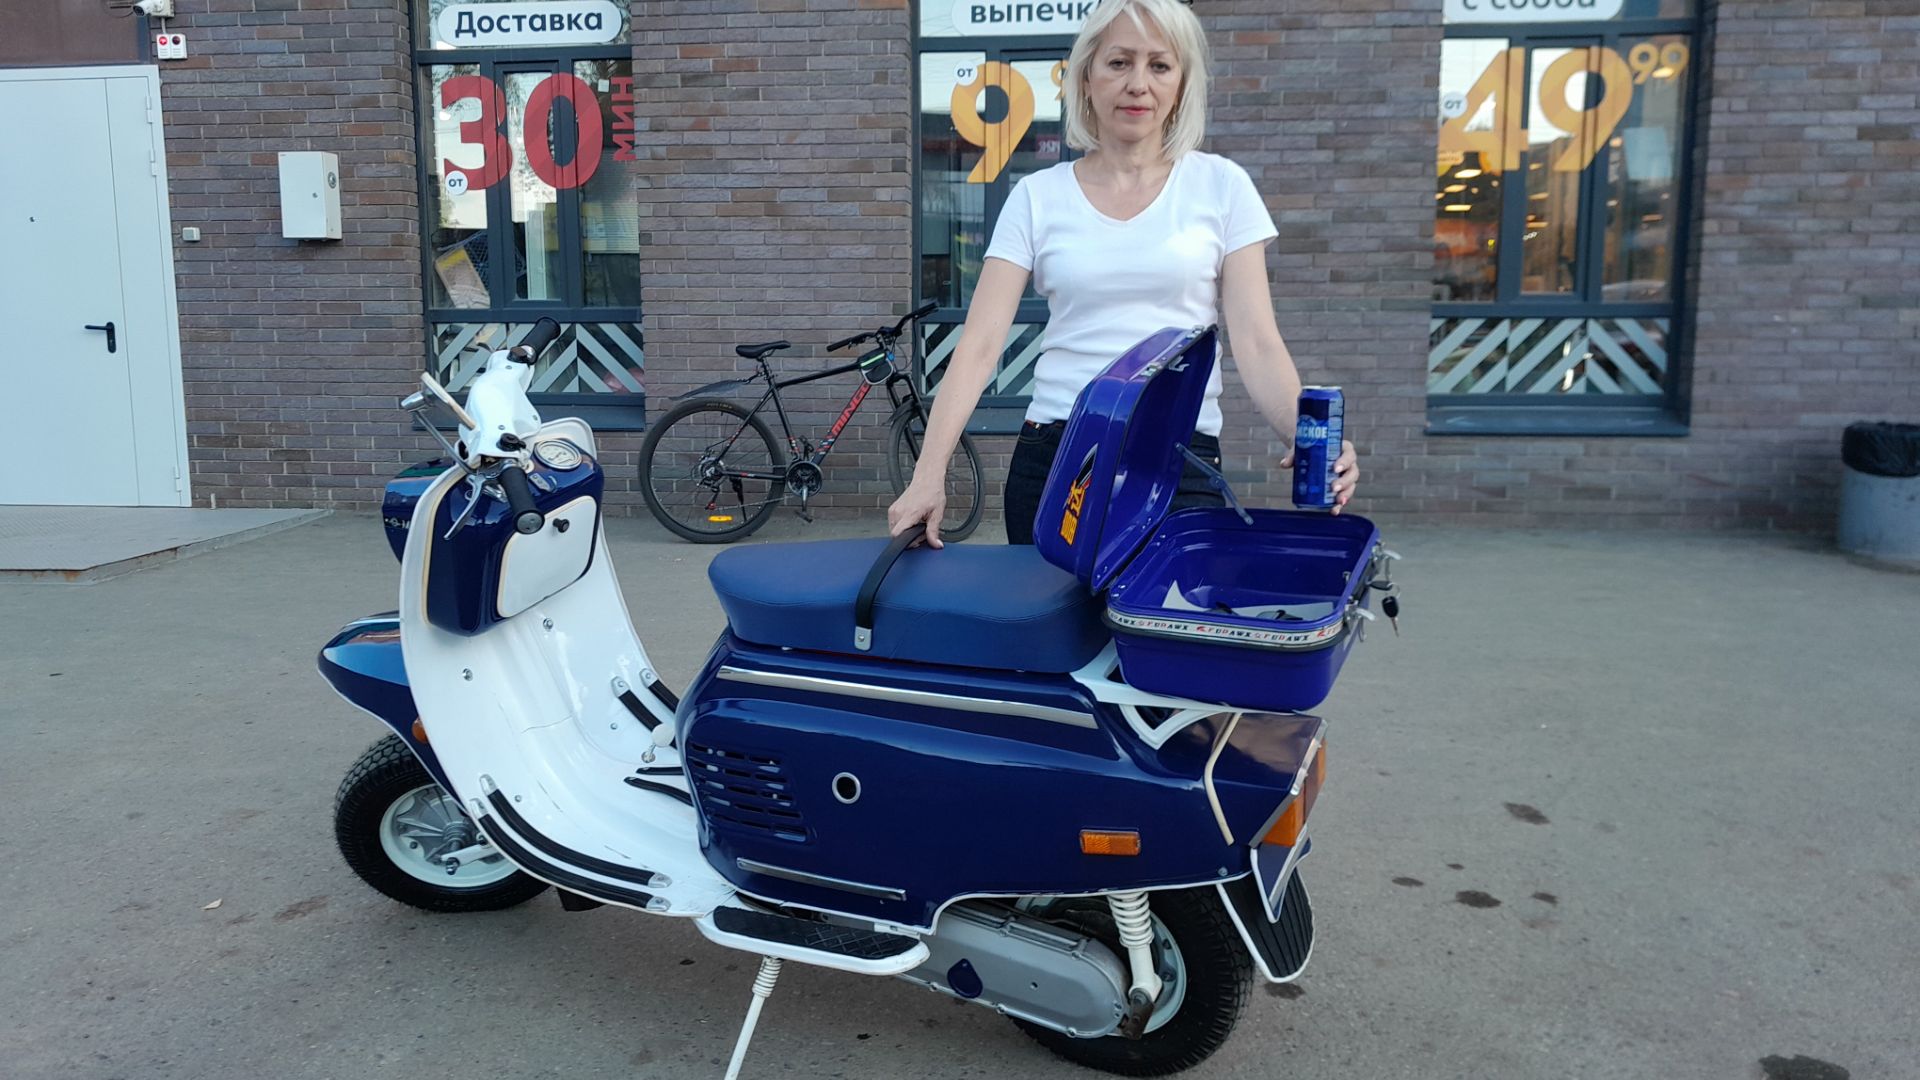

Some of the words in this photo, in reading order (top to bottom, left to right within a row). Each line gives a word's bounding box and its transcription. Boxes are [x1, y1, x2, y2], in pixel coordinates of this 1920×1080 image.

[455, 11, 602, 38] Доставка
[970, 0, 1099, 23] выпечк
[441, 72, 603, 190] 30
[950, 60, 1035, 184] 9
[1437, 46, 1633, 172] 49
[1629, 42, 1689, 84] 99
